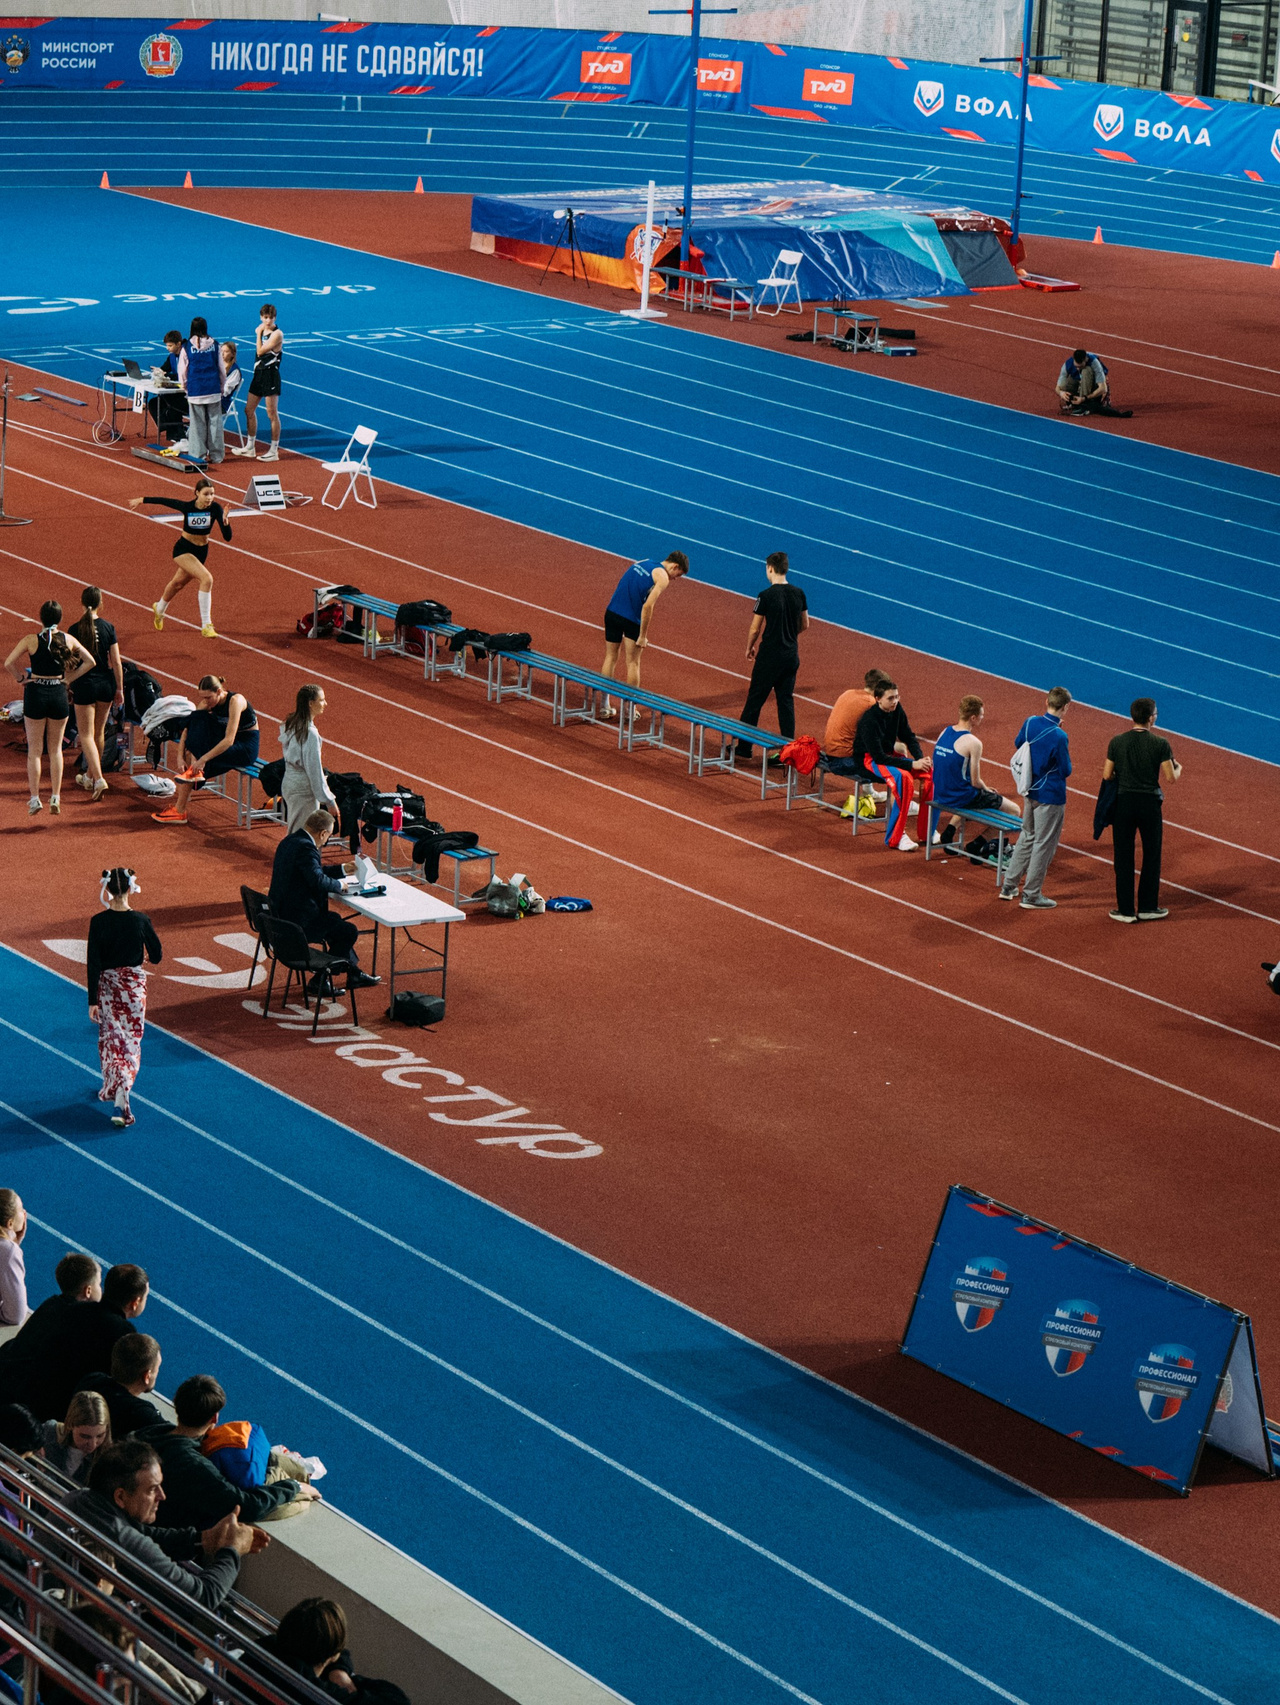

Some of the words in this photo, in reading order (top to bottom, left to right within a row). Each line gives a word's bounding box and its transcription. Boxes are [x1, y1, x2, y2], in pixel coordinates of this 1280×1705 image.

[42, 42, 114, 53] МИНСПОРТ
[42, 57, 96, 69] РОССИИ
[211, 42, 313, 75] НИКОГДА
[322, 44, 348, 73] НЕ
[356, 42, 484, 77] СДАВАЙСЯ!
[1134, 118, 1211, 147] ВФЛА
[257, 489, 281, 497] UCS
[191, 517, 207, 526] 609
[956, 1277, 1010, 1295] ПРОФЕССИОНАЛ
[1045, 1320, 1101, 1338] ПРОФЕССИОНАЛ
[1138, 1365, 1197, 1384] ПРОФЕССИОНАЛ
